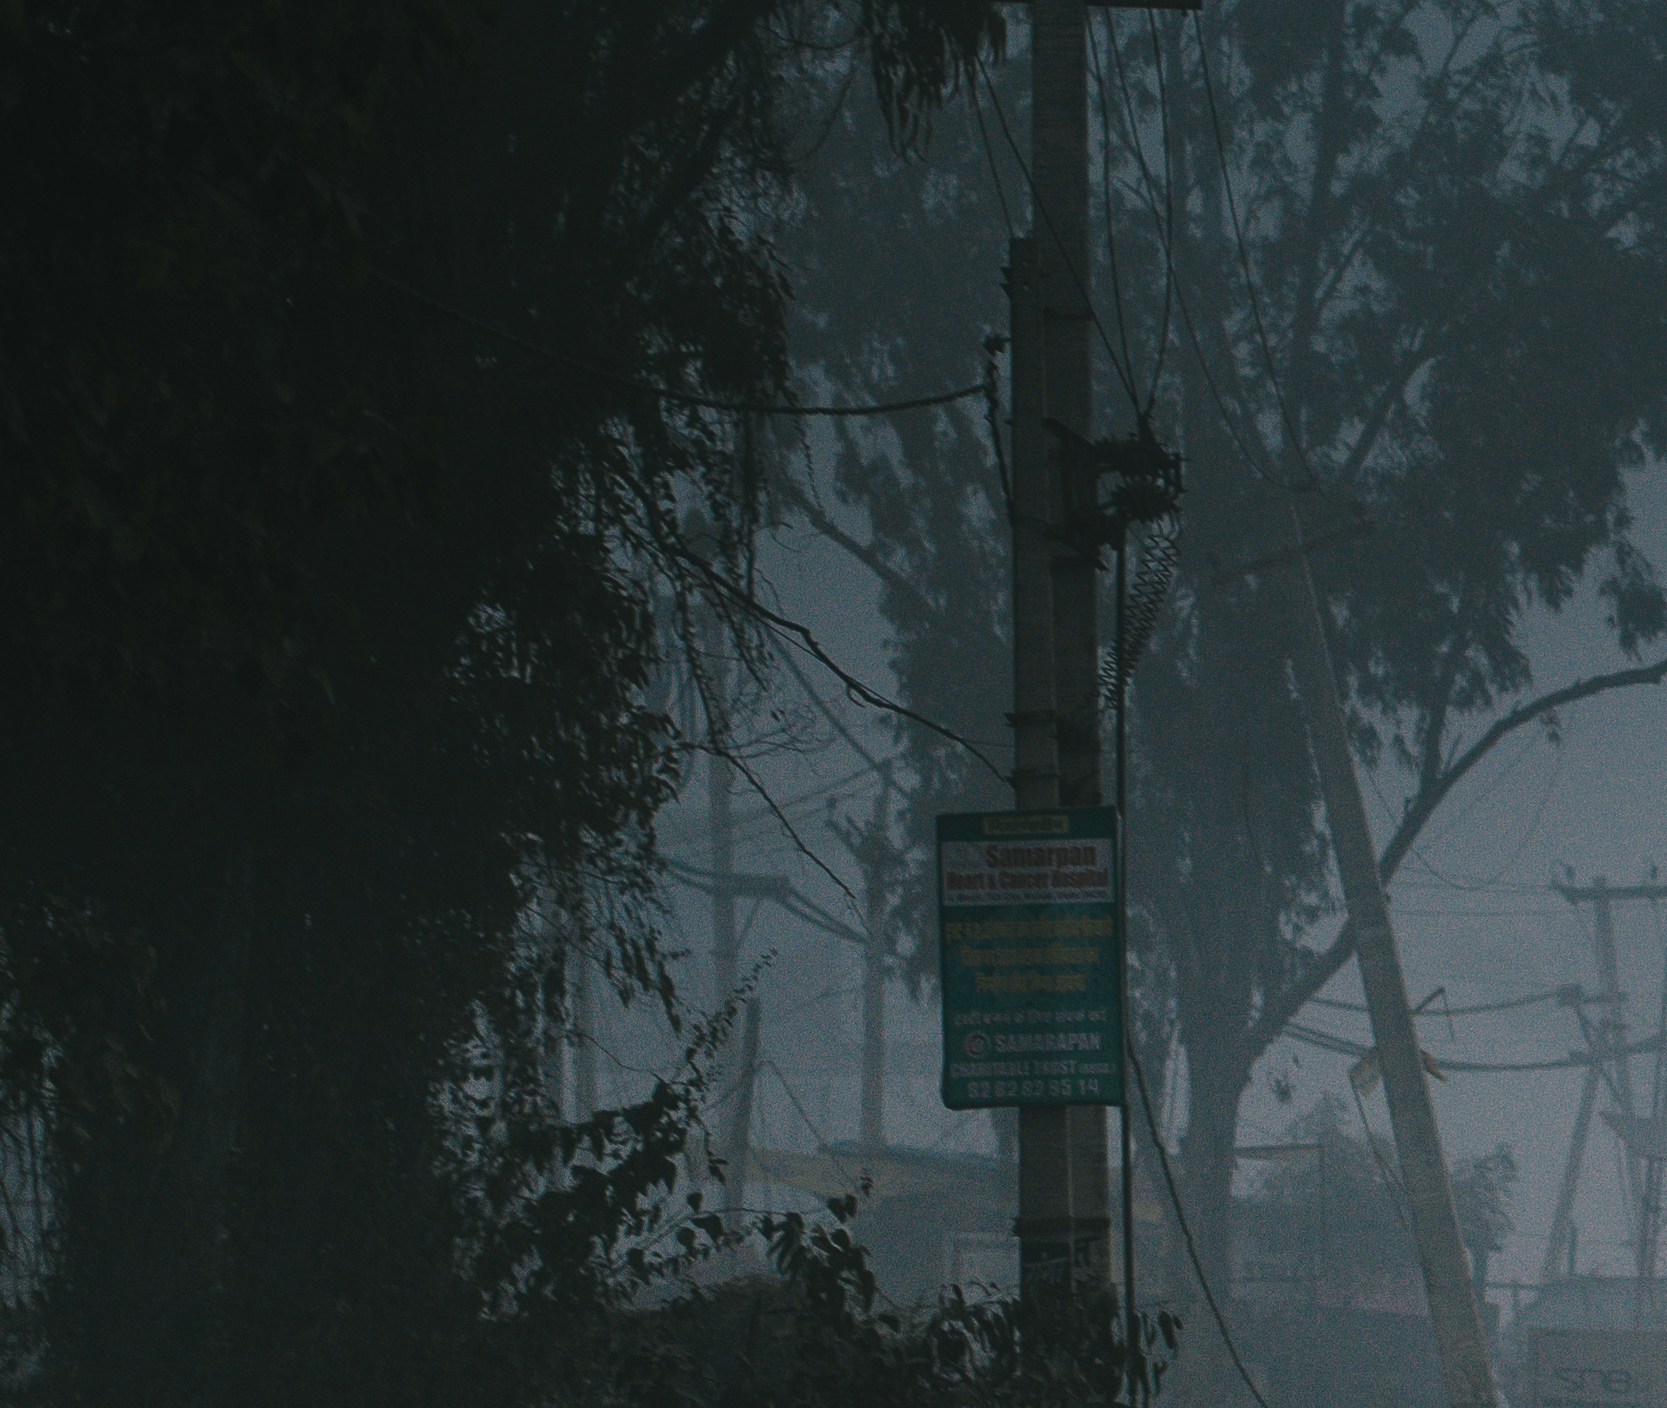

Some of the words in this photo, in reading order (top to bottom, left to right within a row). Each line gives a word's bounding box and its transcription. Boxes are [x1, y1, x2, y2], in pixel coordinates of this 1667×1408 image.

[986, 844, 1096, 868] Samarpan
[994, 1032, 1102, 1052] SAMARAPAN
[1033, 1060, 1077, 1075] TRUST
[1077, 1077, 1101, 1096] 14
